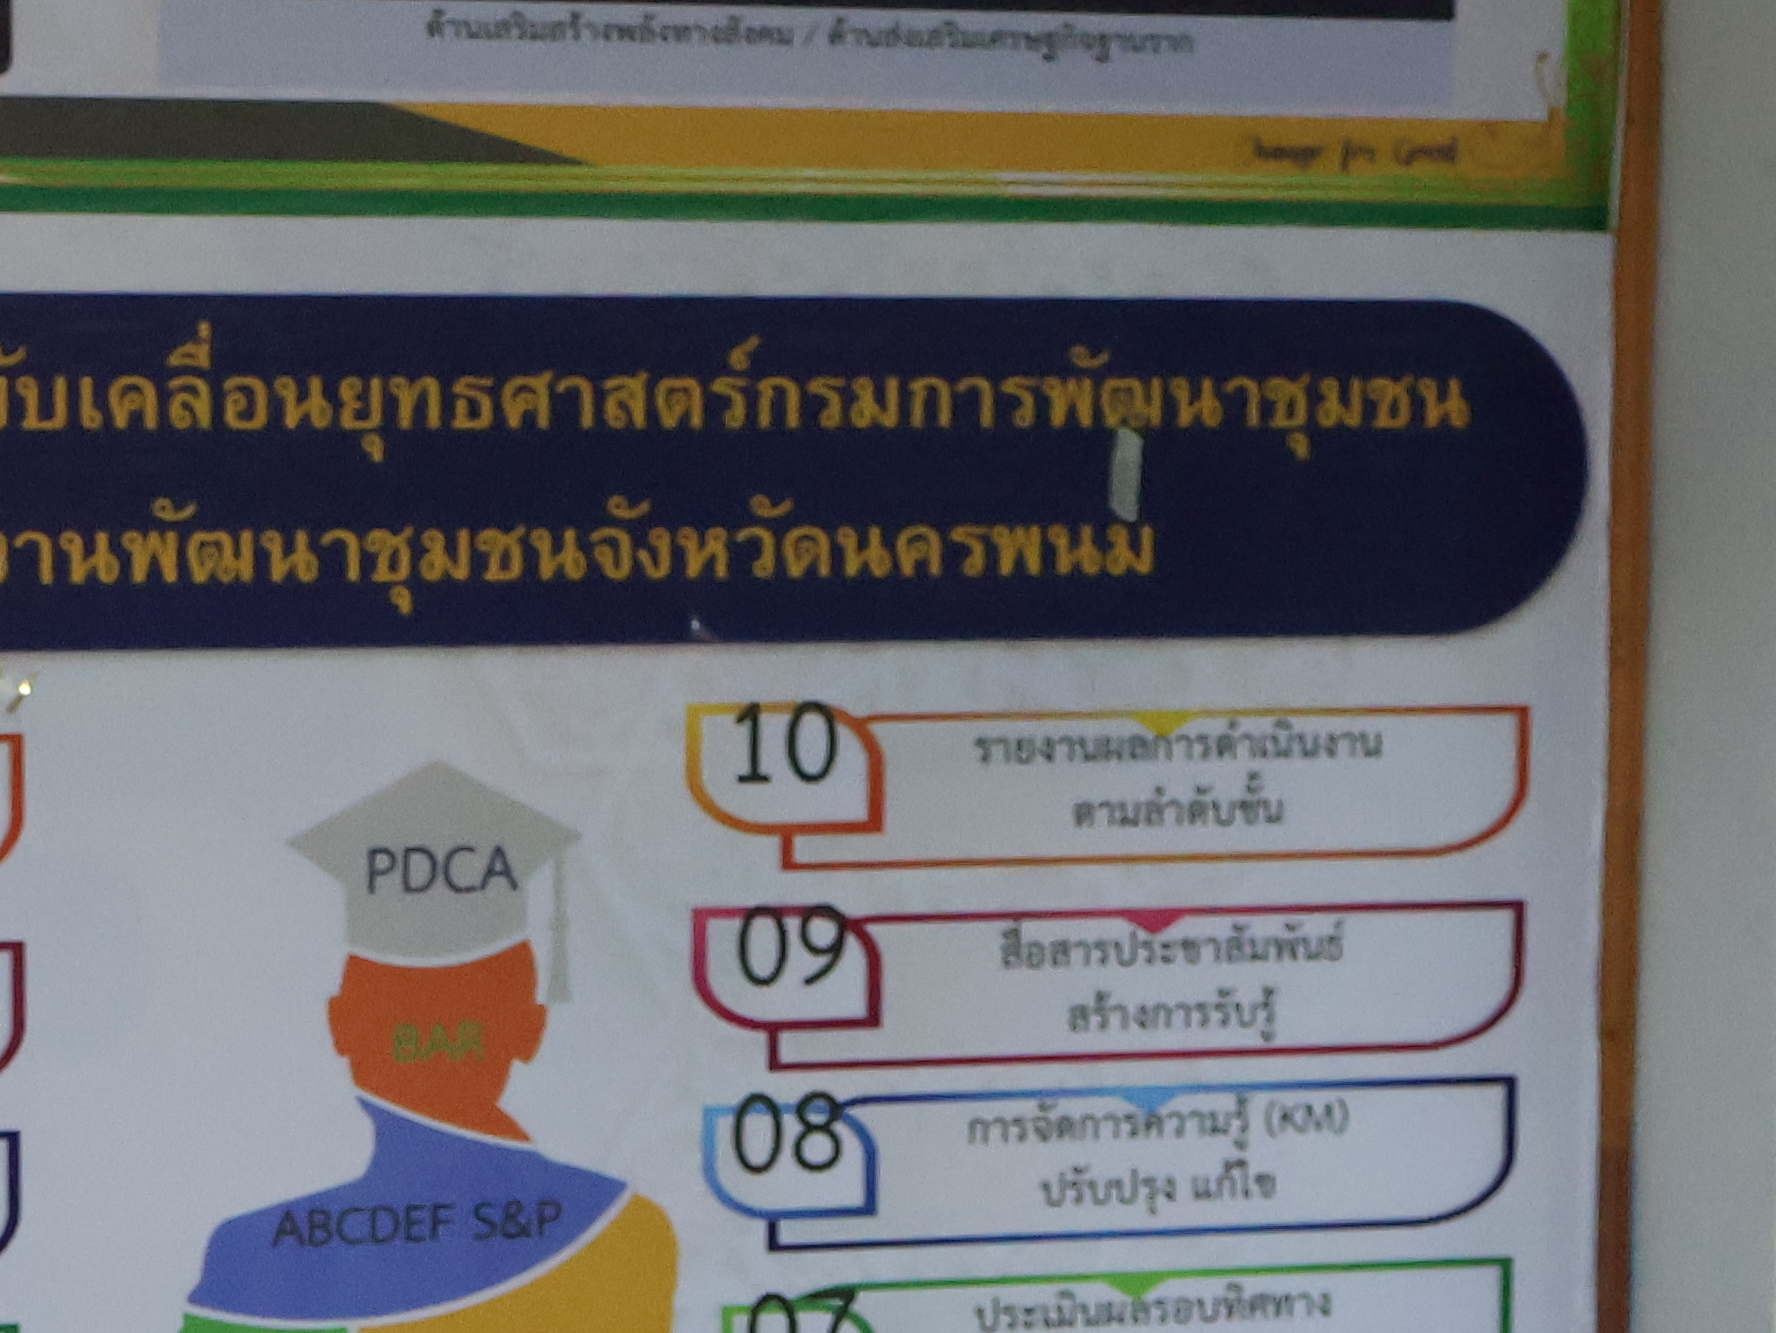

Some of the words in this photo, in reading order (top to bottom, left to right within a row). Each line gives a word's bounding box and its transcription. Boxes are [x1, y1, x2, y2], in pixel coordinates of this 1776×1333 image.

[734, 701, 840, 785] 10
[365, 844, 518, 895] PDCA
[737, 904, 848, 988] 09
[1001, 920, 1344, 970] สื่อสารประชาสัมพันธ์
[390, 1020, 487, 1063] BAR
[1066, 988, 1278, 1044] สร้างการรับรู้
[733, 1091, 844, 1174] 08
[966, 1101, 1251, 1152] การจัดการความรู้
[1264, 1099, 1351, 1138] (KM)
[1040, 1164, 1177, 1211] ปรับปรุง
[1192, 1159, 1278, 1202] แก้ไข
[272, 1203, 451, 1249] ABCDEF
[470, 1198, 564, 1242] S&P
